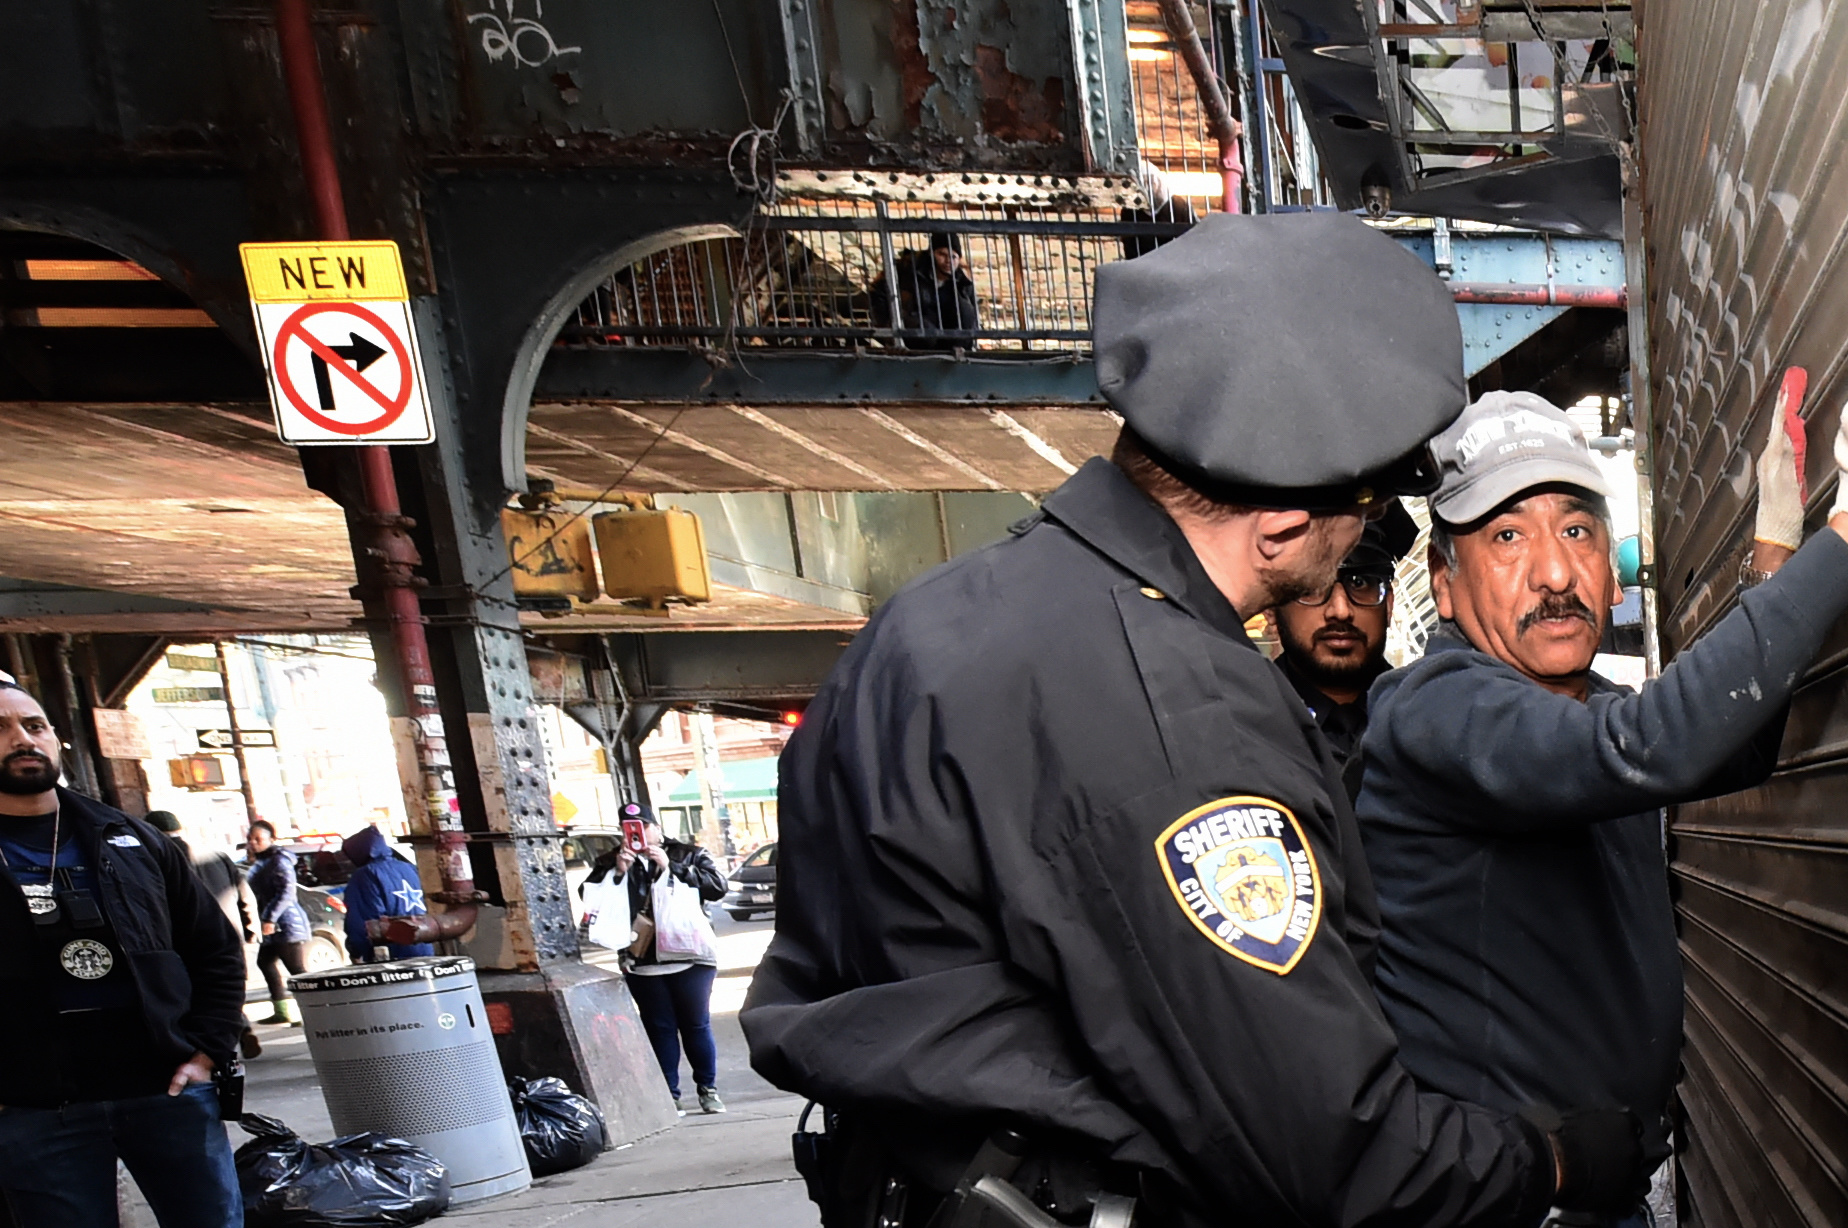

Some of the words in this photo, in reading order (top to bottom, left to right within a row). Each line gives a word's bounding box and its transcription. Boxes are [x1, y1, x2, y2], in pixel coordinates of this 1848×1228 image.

[279, 256, 366, 289] NEW
[209, 734, 232, 743] ONE
[1174, 808, 1284, 864] SHERIFF
[1288, 850, 1314, 896] YORK
[1179, 877, 1218, 920] CITY
[1216, 920, 1244, 943] OF
[1286, 899, 1314, 942] NEW
[63, 941, 84, 958] GUNS
[86, 942, 107, 956] AND
[340, 974, 376, 987] Don't
[382, 971, 415, 982] litter
[434, 965, 462, 976] Don't
[315, 1030, 329, 1039] Put
[330, 1028, 354, 1038] litter
[357, 1027, 367, 1036] in
[370, 1025, 385, 1034] its
[389, 1022, 425, 1033] place.
